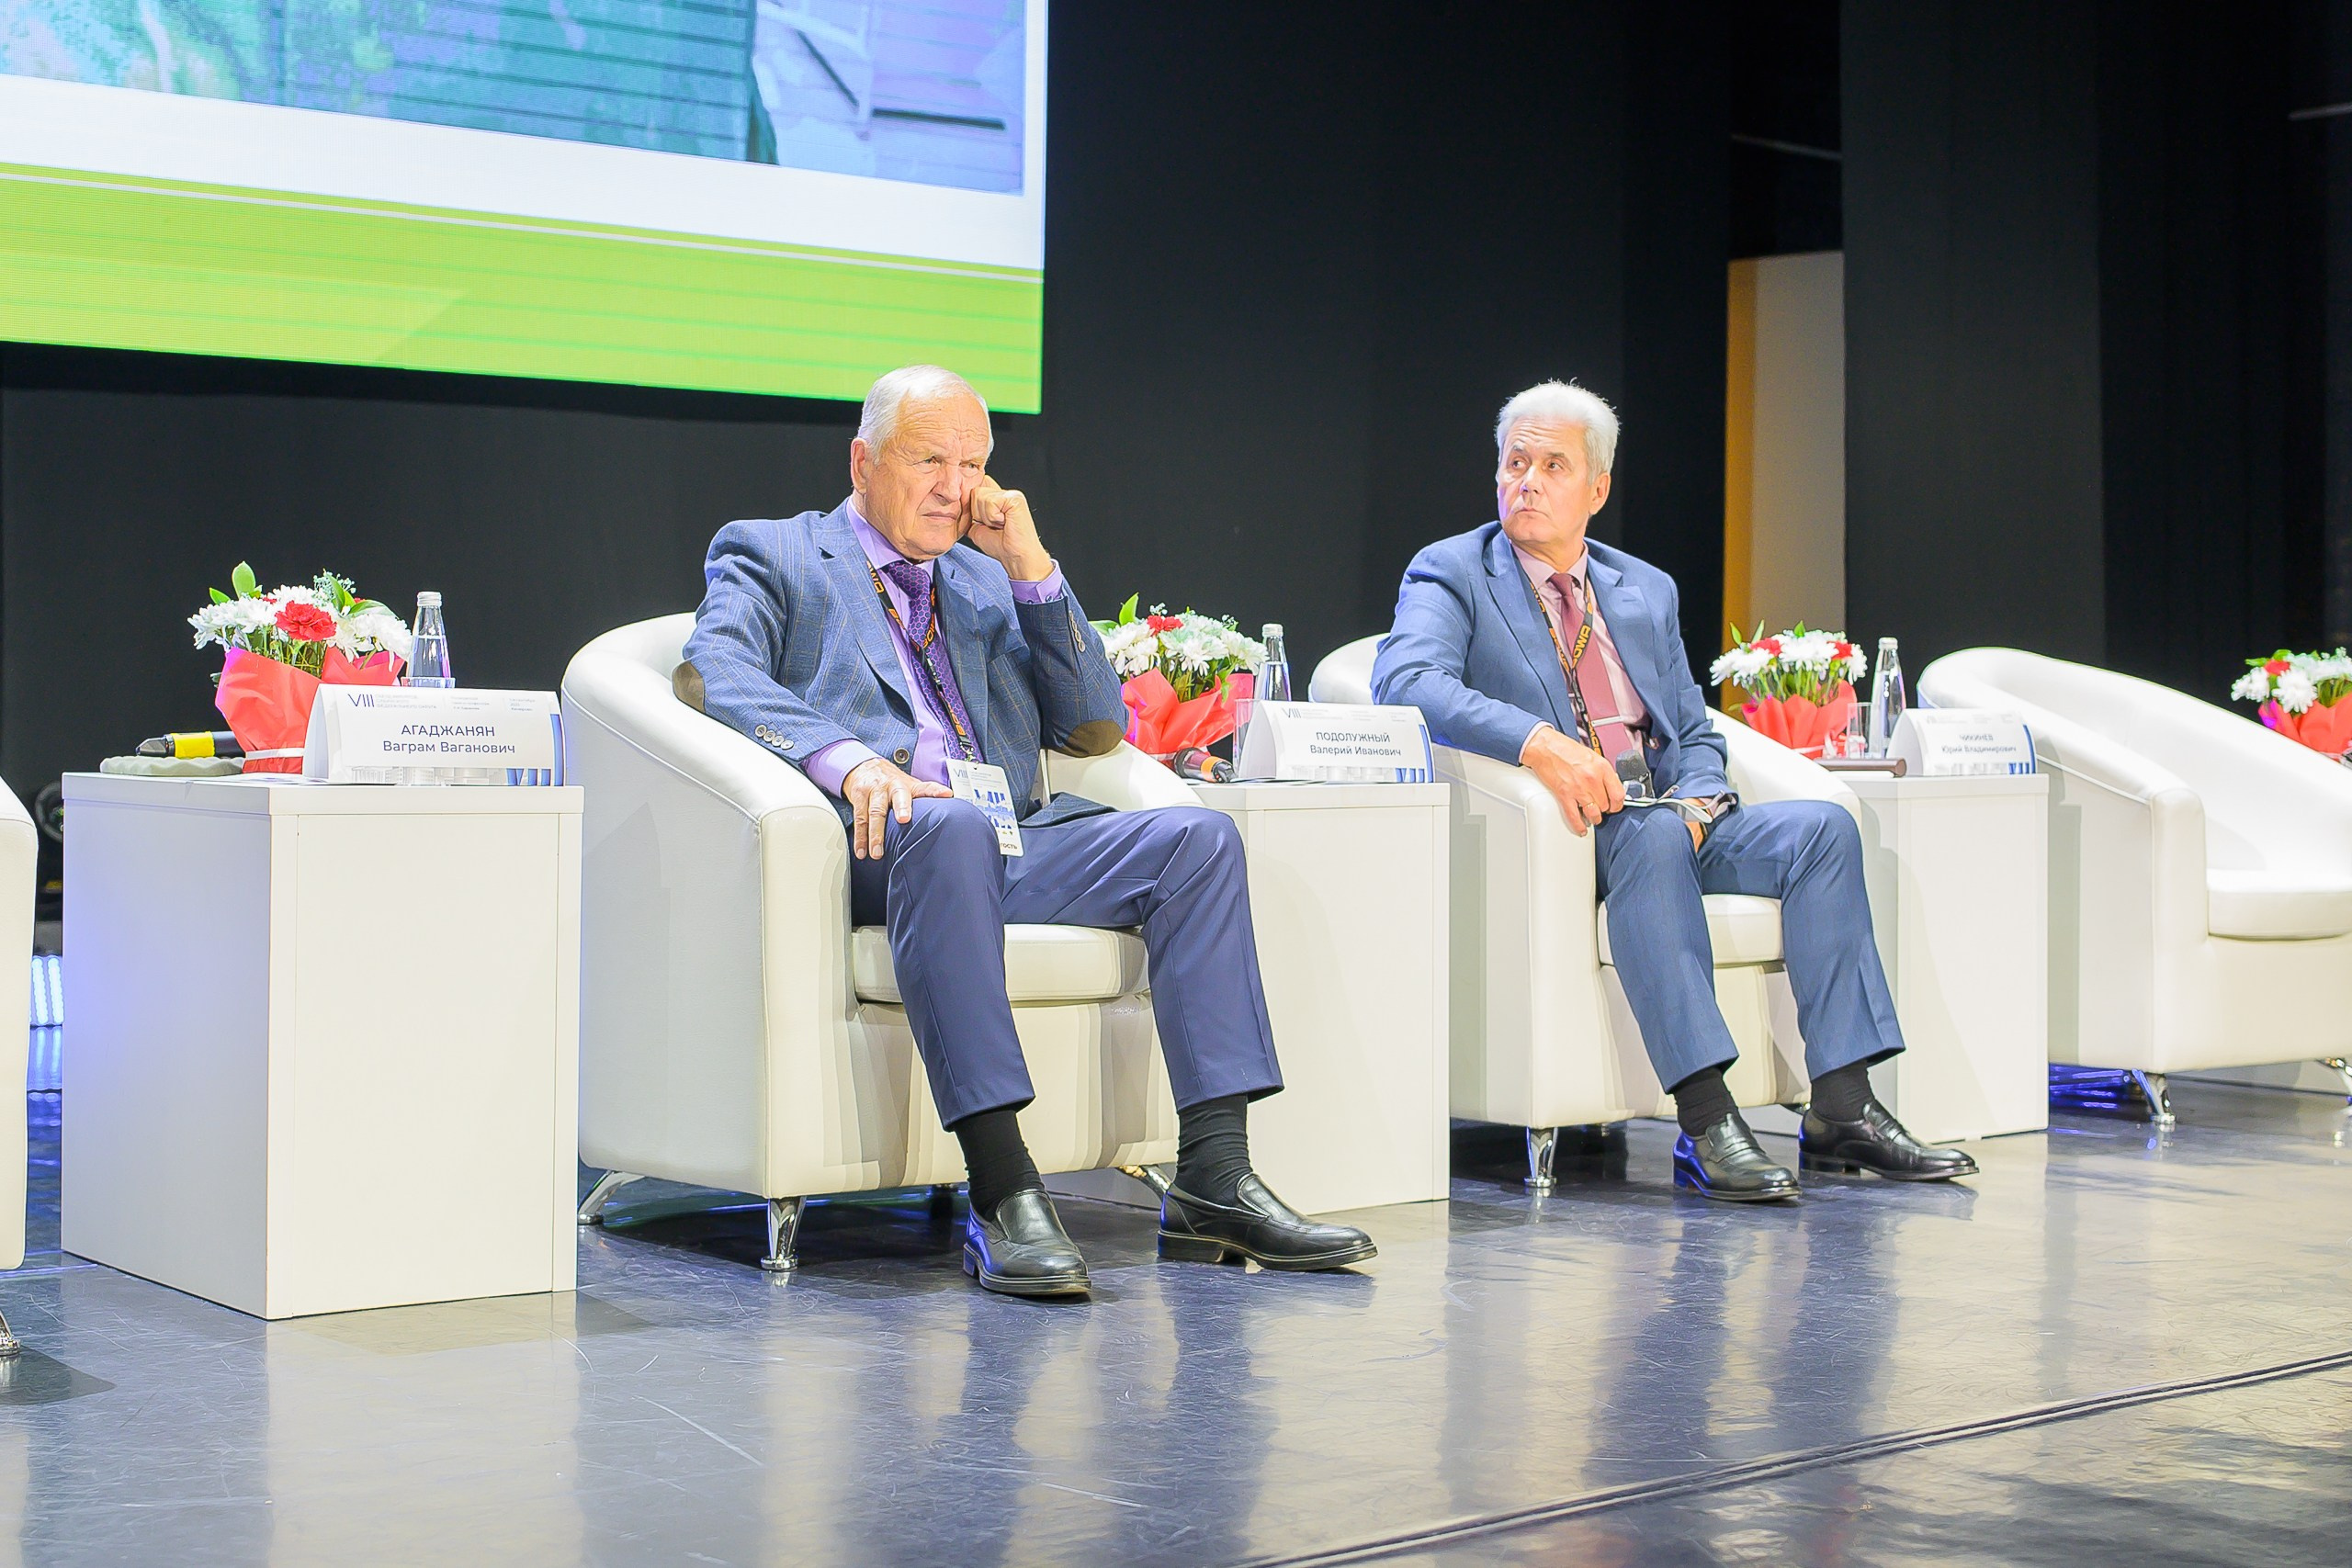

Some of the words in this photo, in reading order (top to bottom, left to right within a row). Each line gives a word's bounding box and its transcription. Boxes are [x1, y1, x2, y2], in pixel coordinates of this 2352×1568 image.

[347, 694, 375, 707] VIII
[401, 724, 495, 737] АГАДЖАНЯН
[1316, 731, 1391, 743] ПОДОЛУЖНЫЙ
[383, 740, 435, 754] Ваграм
[440, 741, 515, 754] Ваганович
[1310, 744, 1352, 756] Валерий
[1355, 746, 1401, 756] Иванович
